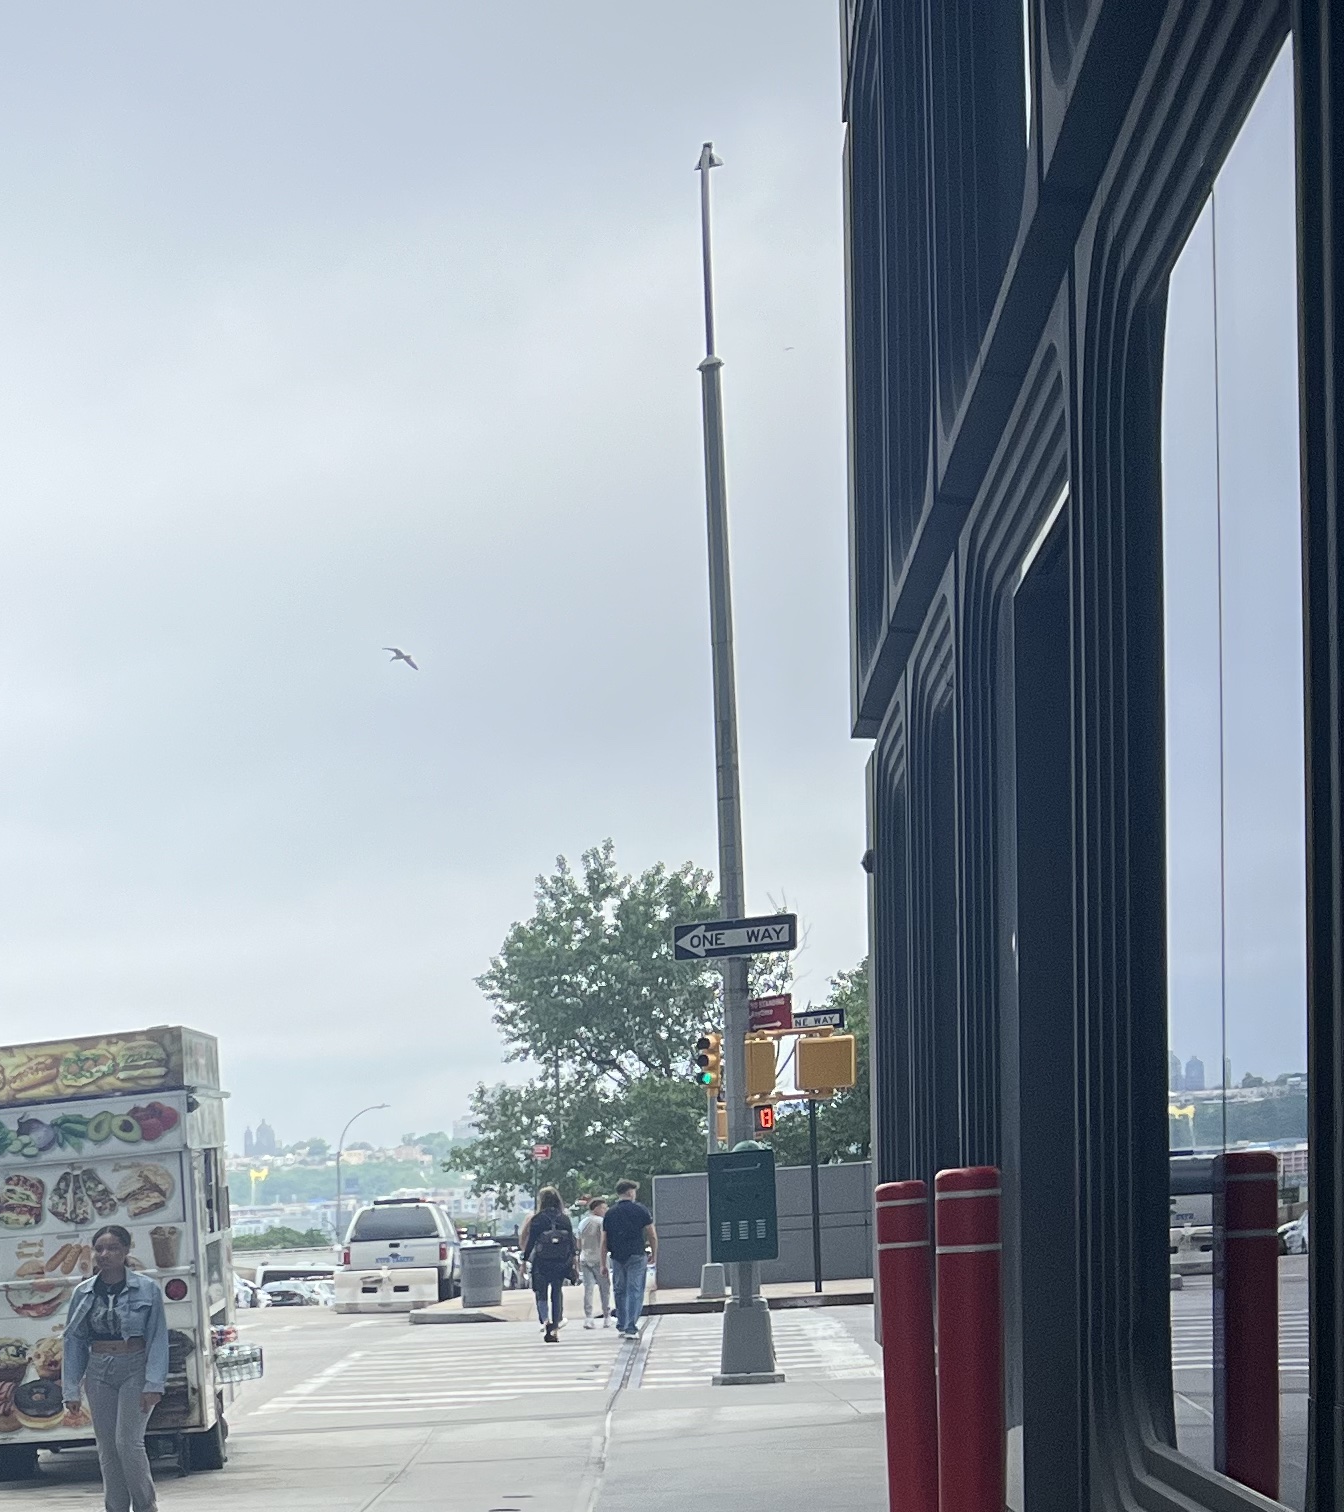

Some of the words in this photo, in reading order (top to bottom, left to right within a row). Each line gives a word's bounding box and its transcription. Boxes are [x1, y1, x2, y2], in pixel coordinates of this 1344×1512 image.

[690, 932, 725, 949] ONE
[746, 926, 785, 943] WAY
[794, 1018, 809, 1028] NE
[814, 1015, 835, 1026] WAY
